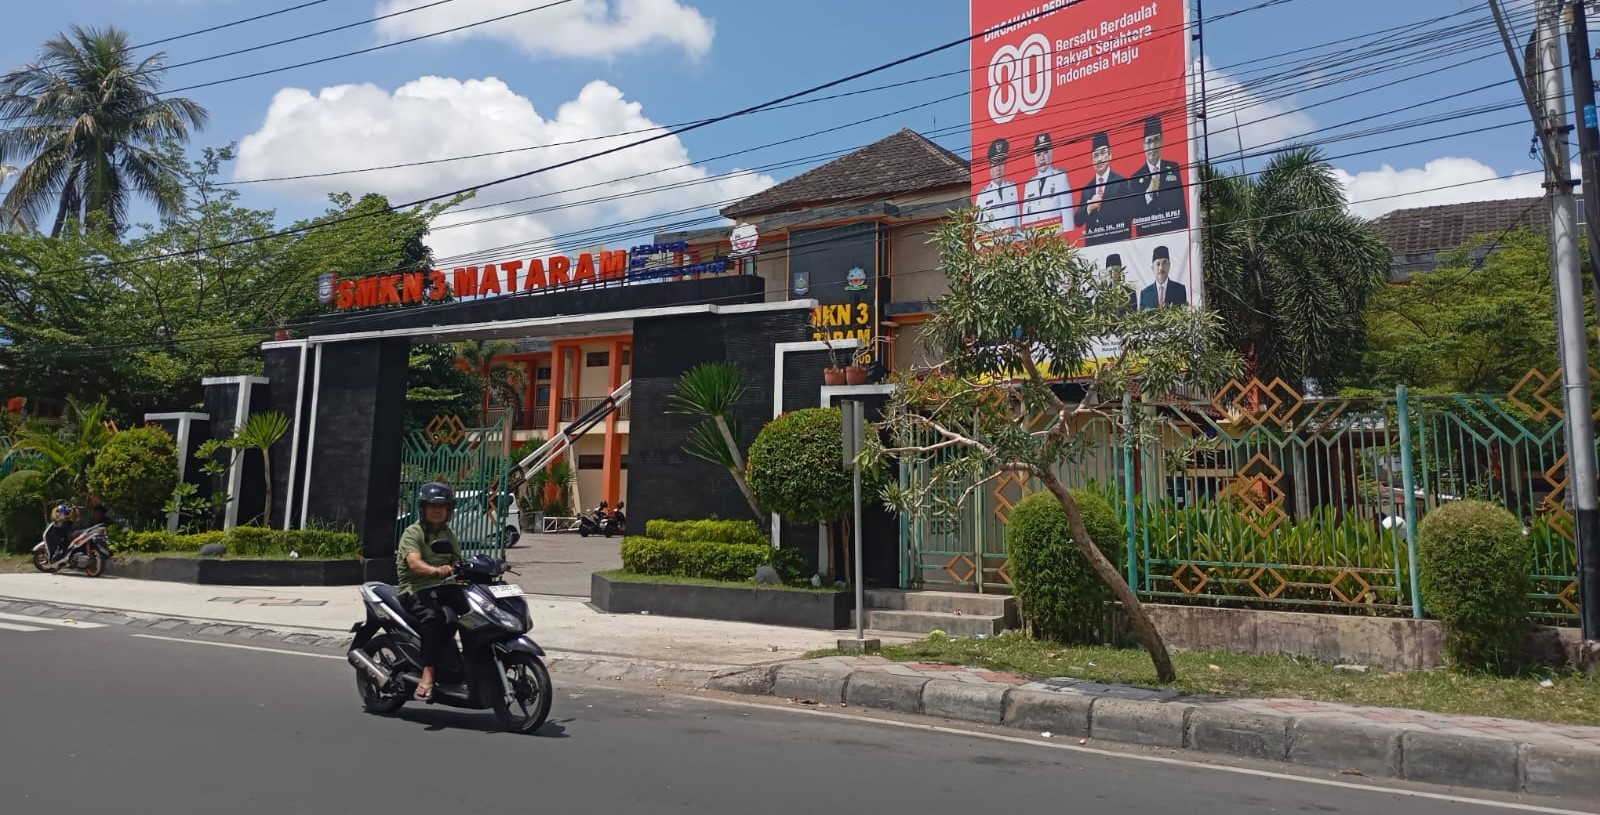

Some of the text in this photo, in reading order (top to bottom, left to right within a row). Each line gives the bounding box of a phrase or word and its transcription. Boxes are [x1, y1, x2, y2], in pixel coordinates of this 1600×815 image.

[984, 7, 1040, 42] DIRGAHAYU
[1055, 2, 1157, 52] Bersatu Berdaulat
[1056, 23, 1152, 70] Rakyat Sejahtera
[988, 33, 1052, 124] 80
[1056, 45, 1139, 86] Indonesia Maju
[338, 249, 626, 309] SMKN 3 MATARAM
[856, 302, 869, 325] 3
